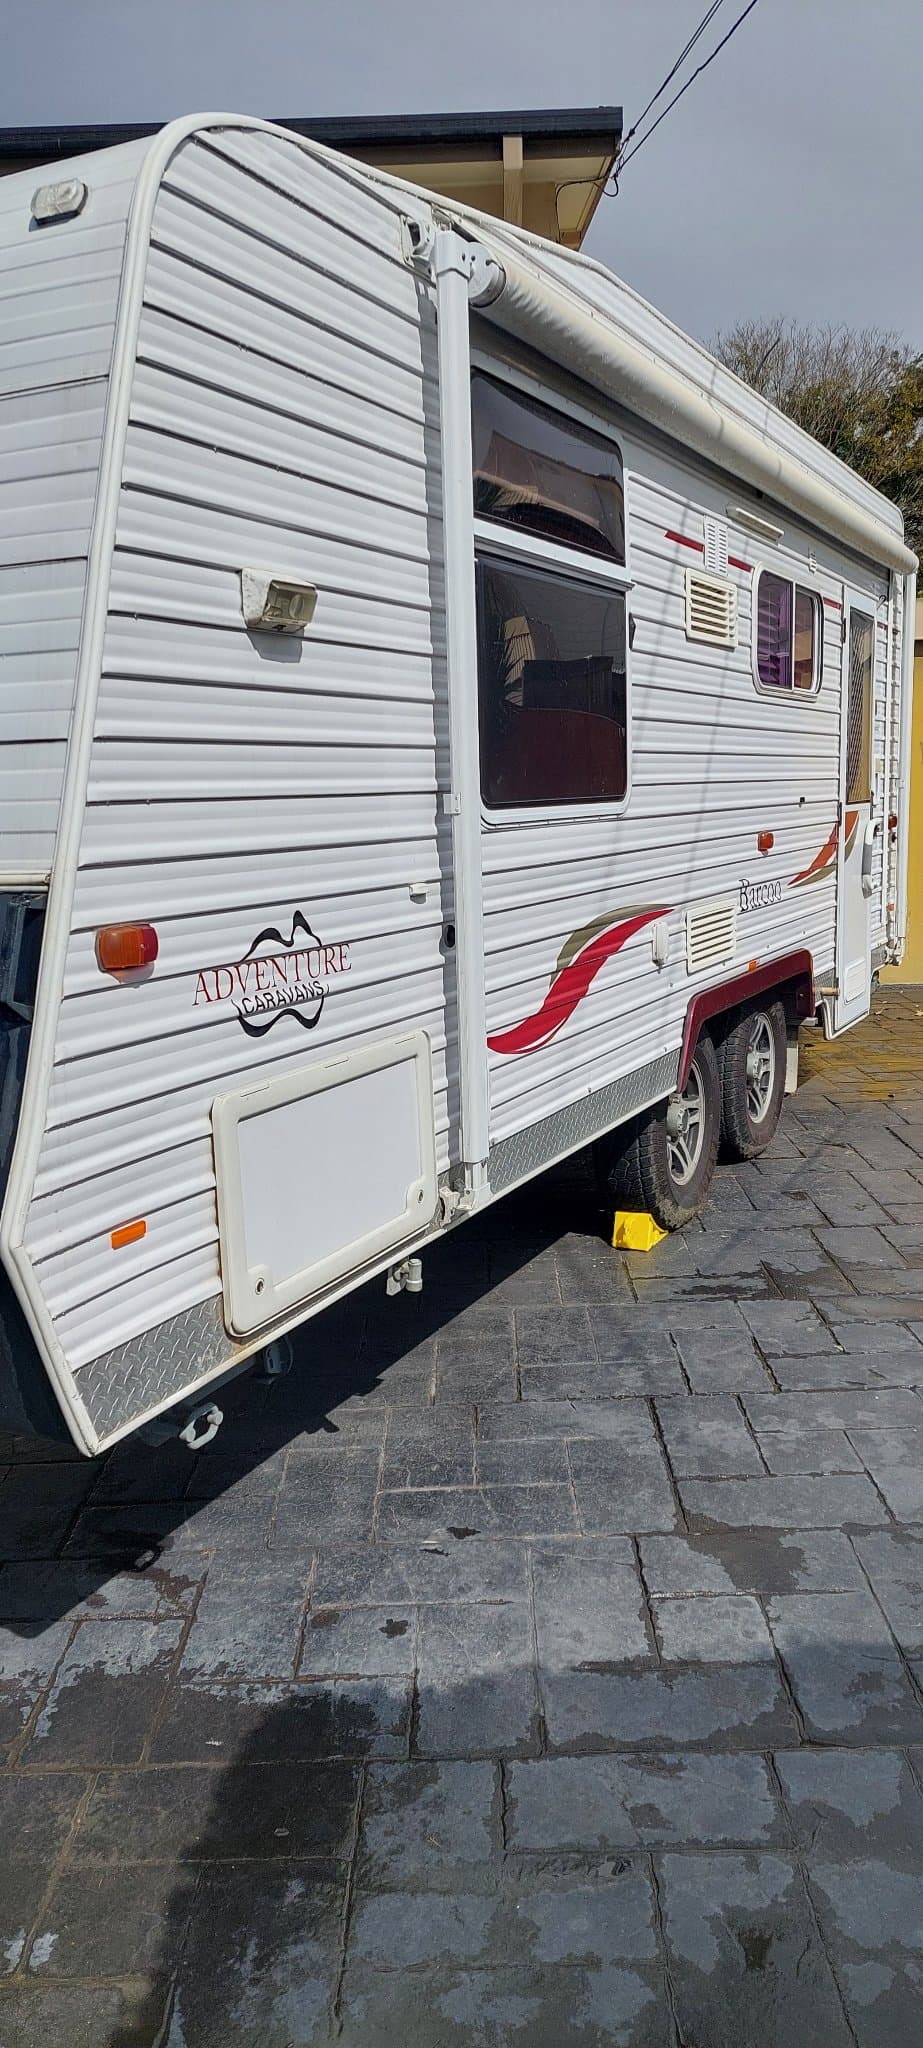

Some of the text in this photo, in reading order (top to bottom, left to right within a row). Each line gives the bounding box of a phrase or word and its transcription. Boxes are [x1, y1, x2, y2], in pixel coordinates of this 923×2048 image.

[738, 879, 782, 912] Barcoo
[192, 943, 352, 1006] ADVENTURE
[241, 980, 324, 1015] CARAVANS
